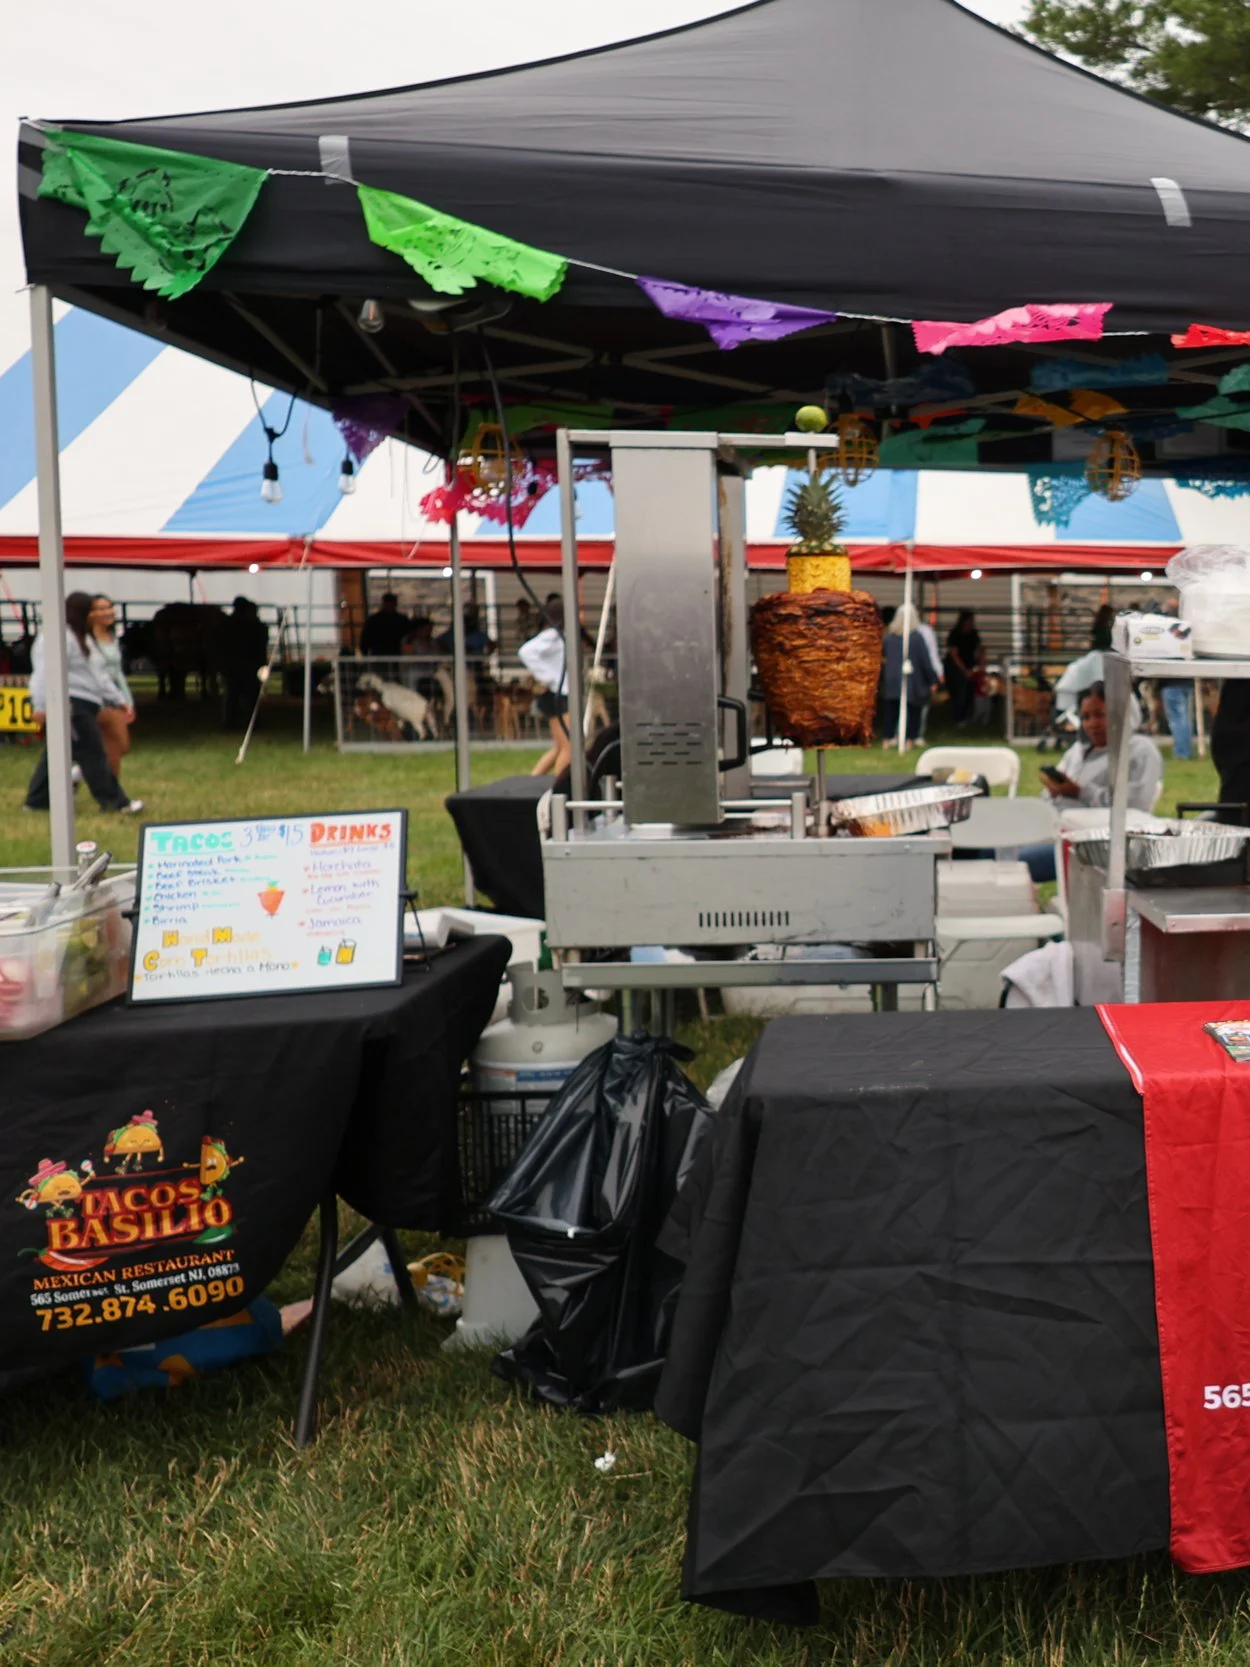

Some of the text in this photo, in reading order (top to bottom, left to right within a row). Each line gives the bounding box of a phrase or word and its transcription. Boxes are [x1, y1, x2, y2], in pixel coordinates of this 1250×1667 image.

[309, 820, 392, 844] DRINKS
[77, 1177, 203, 1218] TACOS
[46, 1195, 233, 1250] BASILIO
[30, 1291, 52, 1307] 565
[114, 1283, 130, 1295] St.
[132, 1273, 187, 1292] Somerset
[32, 1249, 235, 1291] MEXICAN RESTAURANT
